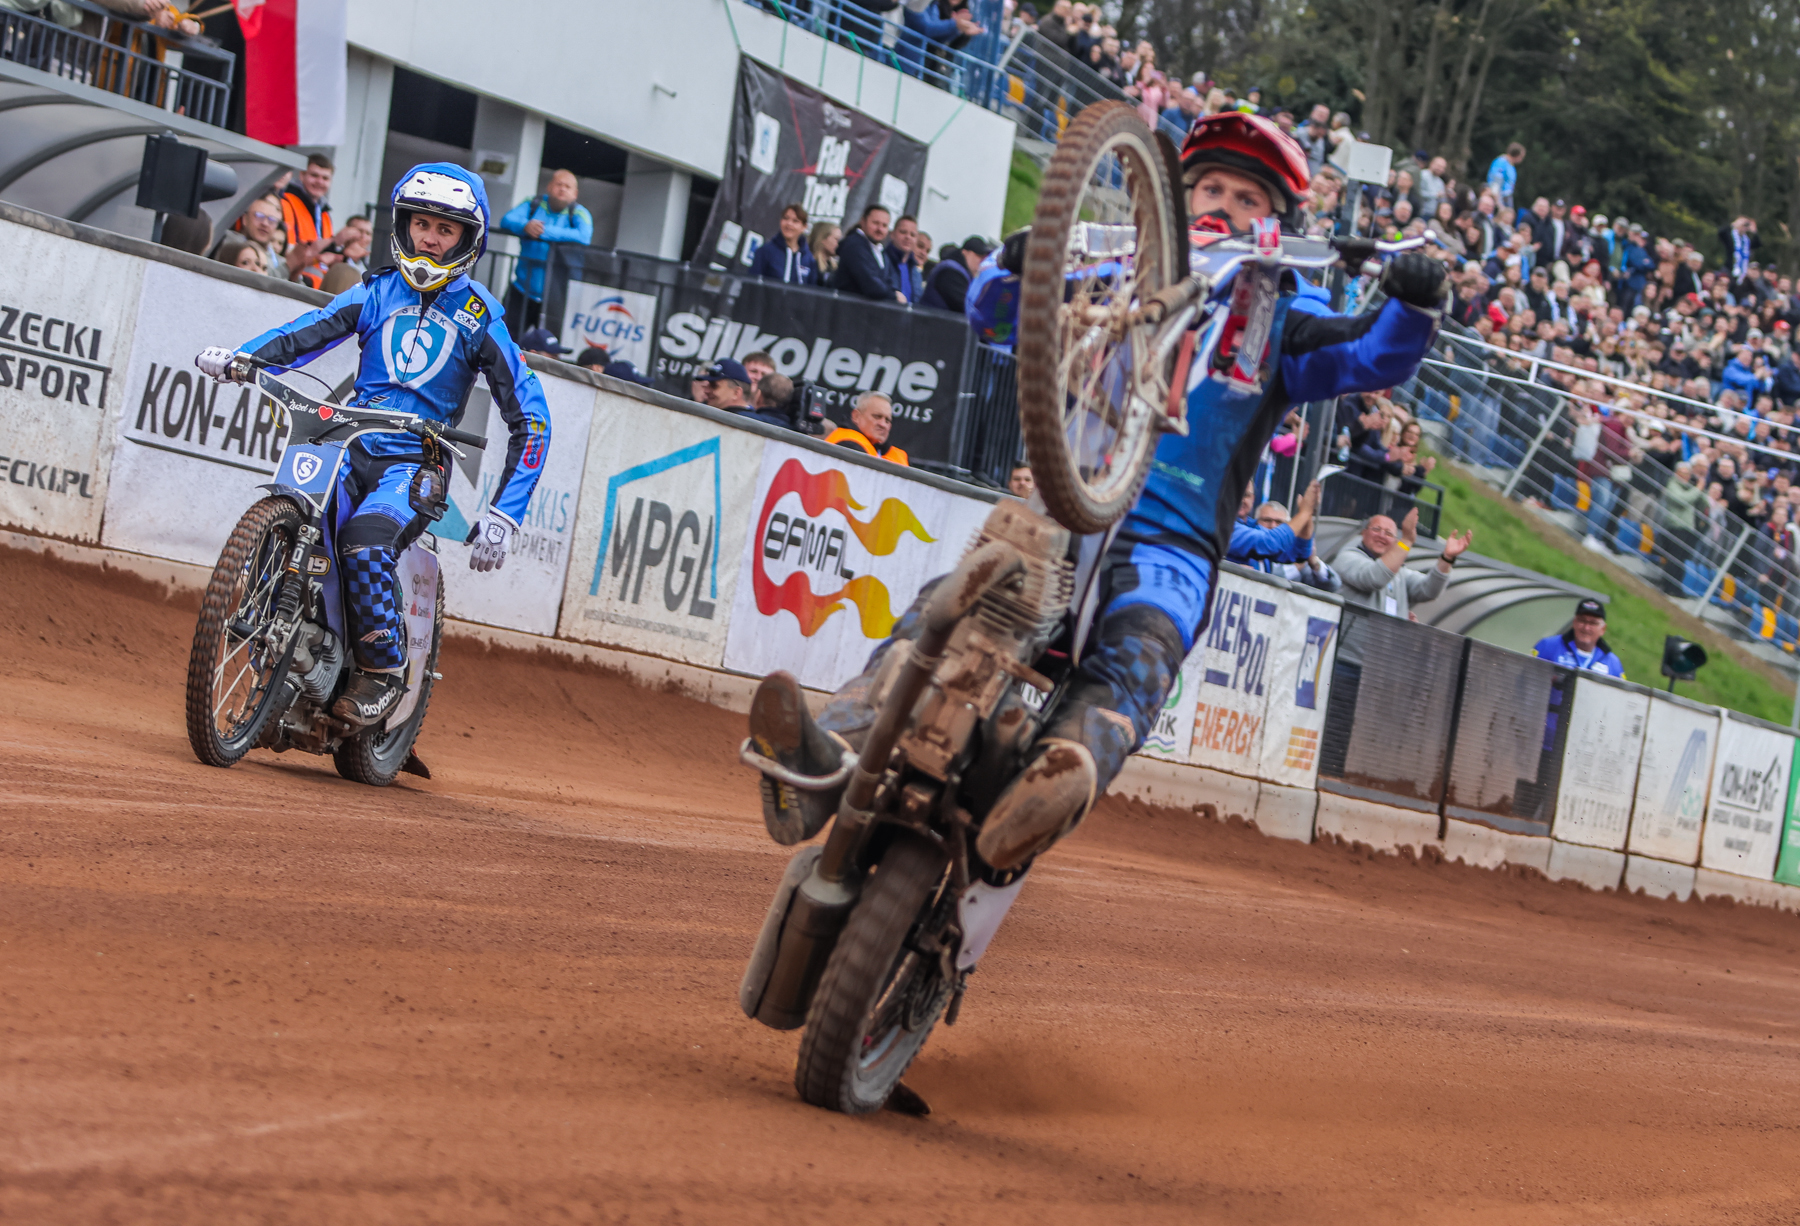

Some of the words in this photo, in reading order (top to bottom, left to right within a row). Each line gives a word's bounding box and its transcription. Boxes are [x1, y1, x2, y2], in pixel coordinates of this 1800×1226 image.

[570, 313, 645, 342] FUCHS
[0, 353, 112, 409] SPORT
[659, 312, 939, 402] Silkolene
[891, 402, 934, 424] OILS
[611, 496, 716, 621] MPGL
[764, 511, 855, 581] BAMAL
[1192, 701, 1262, 758] ENERGY
